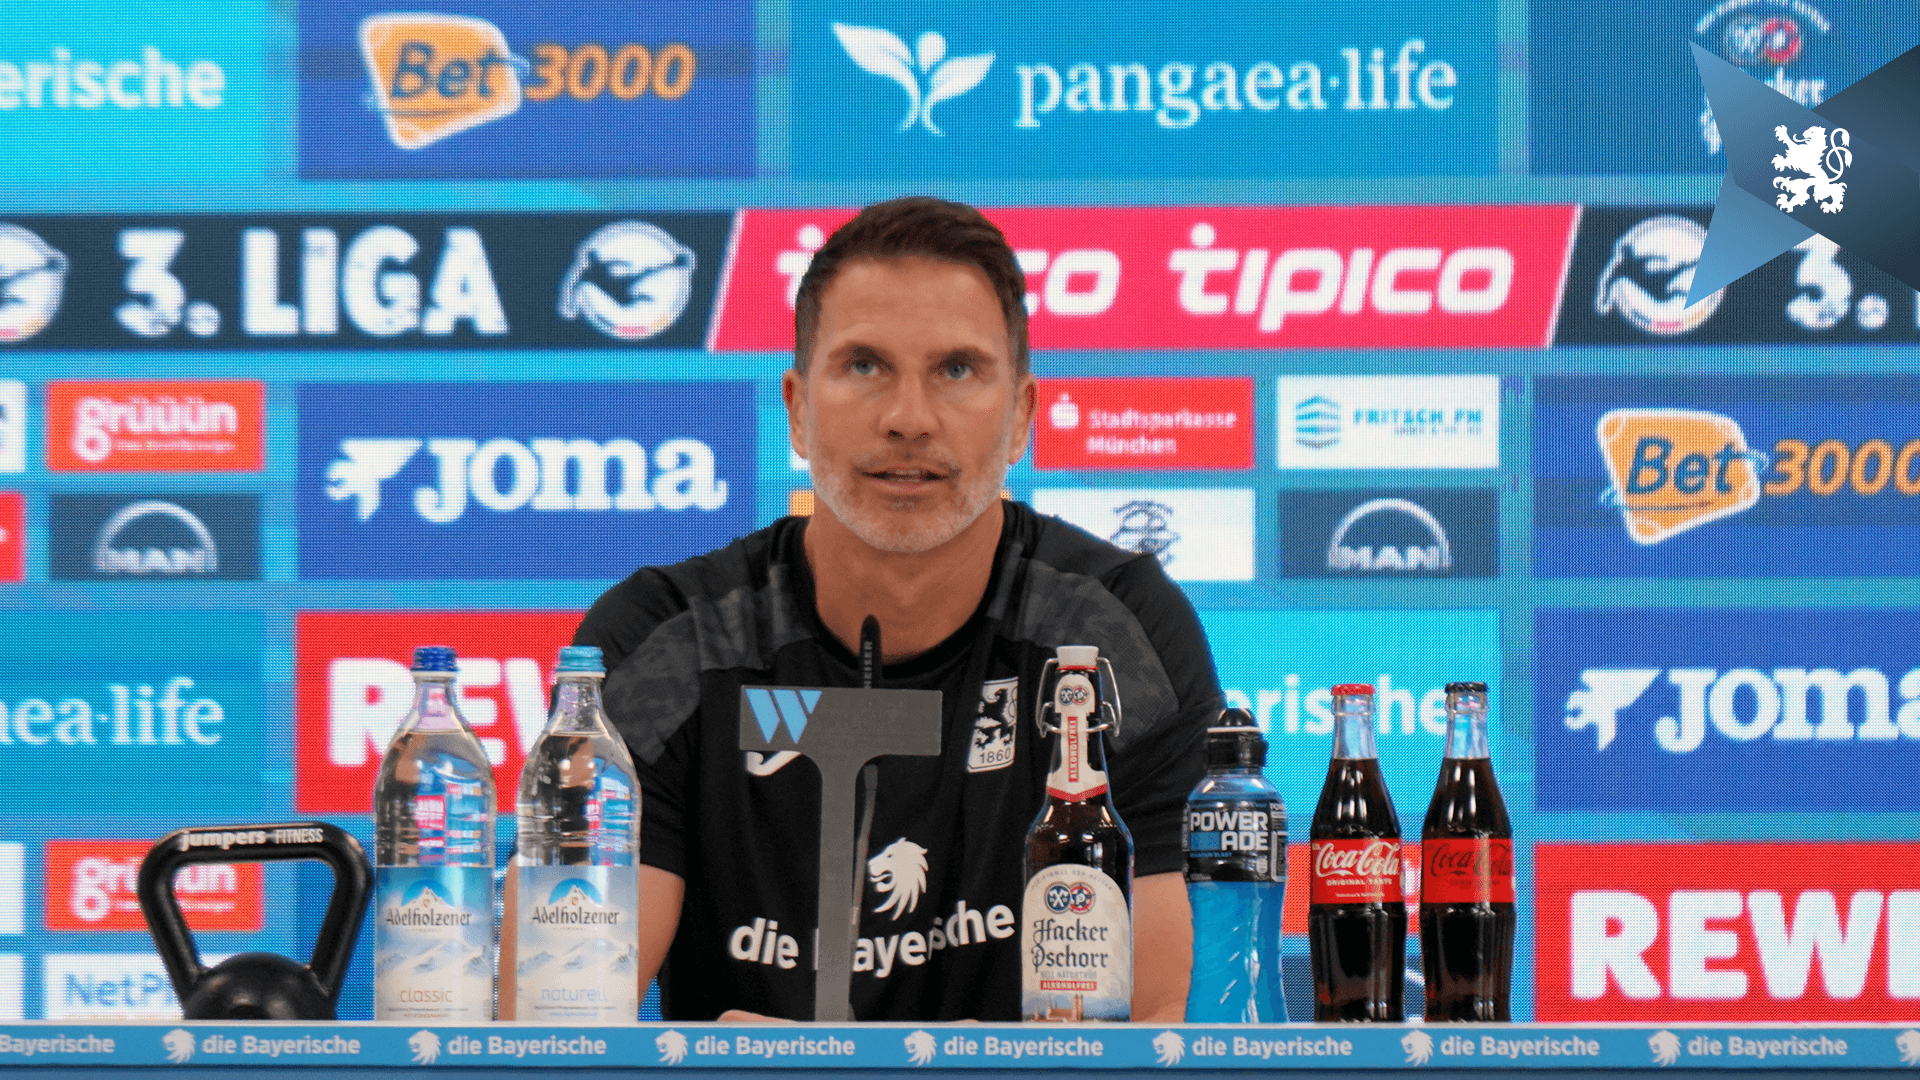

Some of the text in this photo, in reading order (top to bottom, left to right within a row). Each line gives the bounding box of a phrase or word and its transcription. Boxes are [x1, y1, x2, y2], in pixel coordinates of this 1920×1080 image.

[116, 226, 510, 337] 3. LIGA
[1168, 222, 1515, 333] tipico
[1087, 407, 1238, 432] Stadtsparkasse
[1085, 433, 1178, 456] München
[102, 547, 210, 573] MAN
[1334, 544, 1443, 570] MAN
[979, 748, 1011, 765] 1860
[1190, 811, 1269, 832] POWER
[181, 828, 325, 852] jumpers FITNESS
[1221, 831, 1269, 851] ADE
[1326, 878, 1366, 887] ORIGINAL
[386, 907, 473, 927] Adelholzener
[531, 906, 620, 926] Adelholzener
[1032, 917, 1108, 944] Hacker
[728, 916, 799, 970] die
[1030, 944, 1109, 974] Pschorr
[400, 986, 453, 1003] classic
[202, 1035, 360, 1057] die Bayerische
[447, 1036, 607, 1058] die Bayerische
[695, 1036, 855, 1058] die Bayerische
[944, 1036, 1103, 1058] die Bayerische
[1192, 1036, 1353, 1059] die Bayerische
[1440, 1036, 1600, 1058] die Bayerische
[1688, 1036, 1848, 1058] die Bayerische
